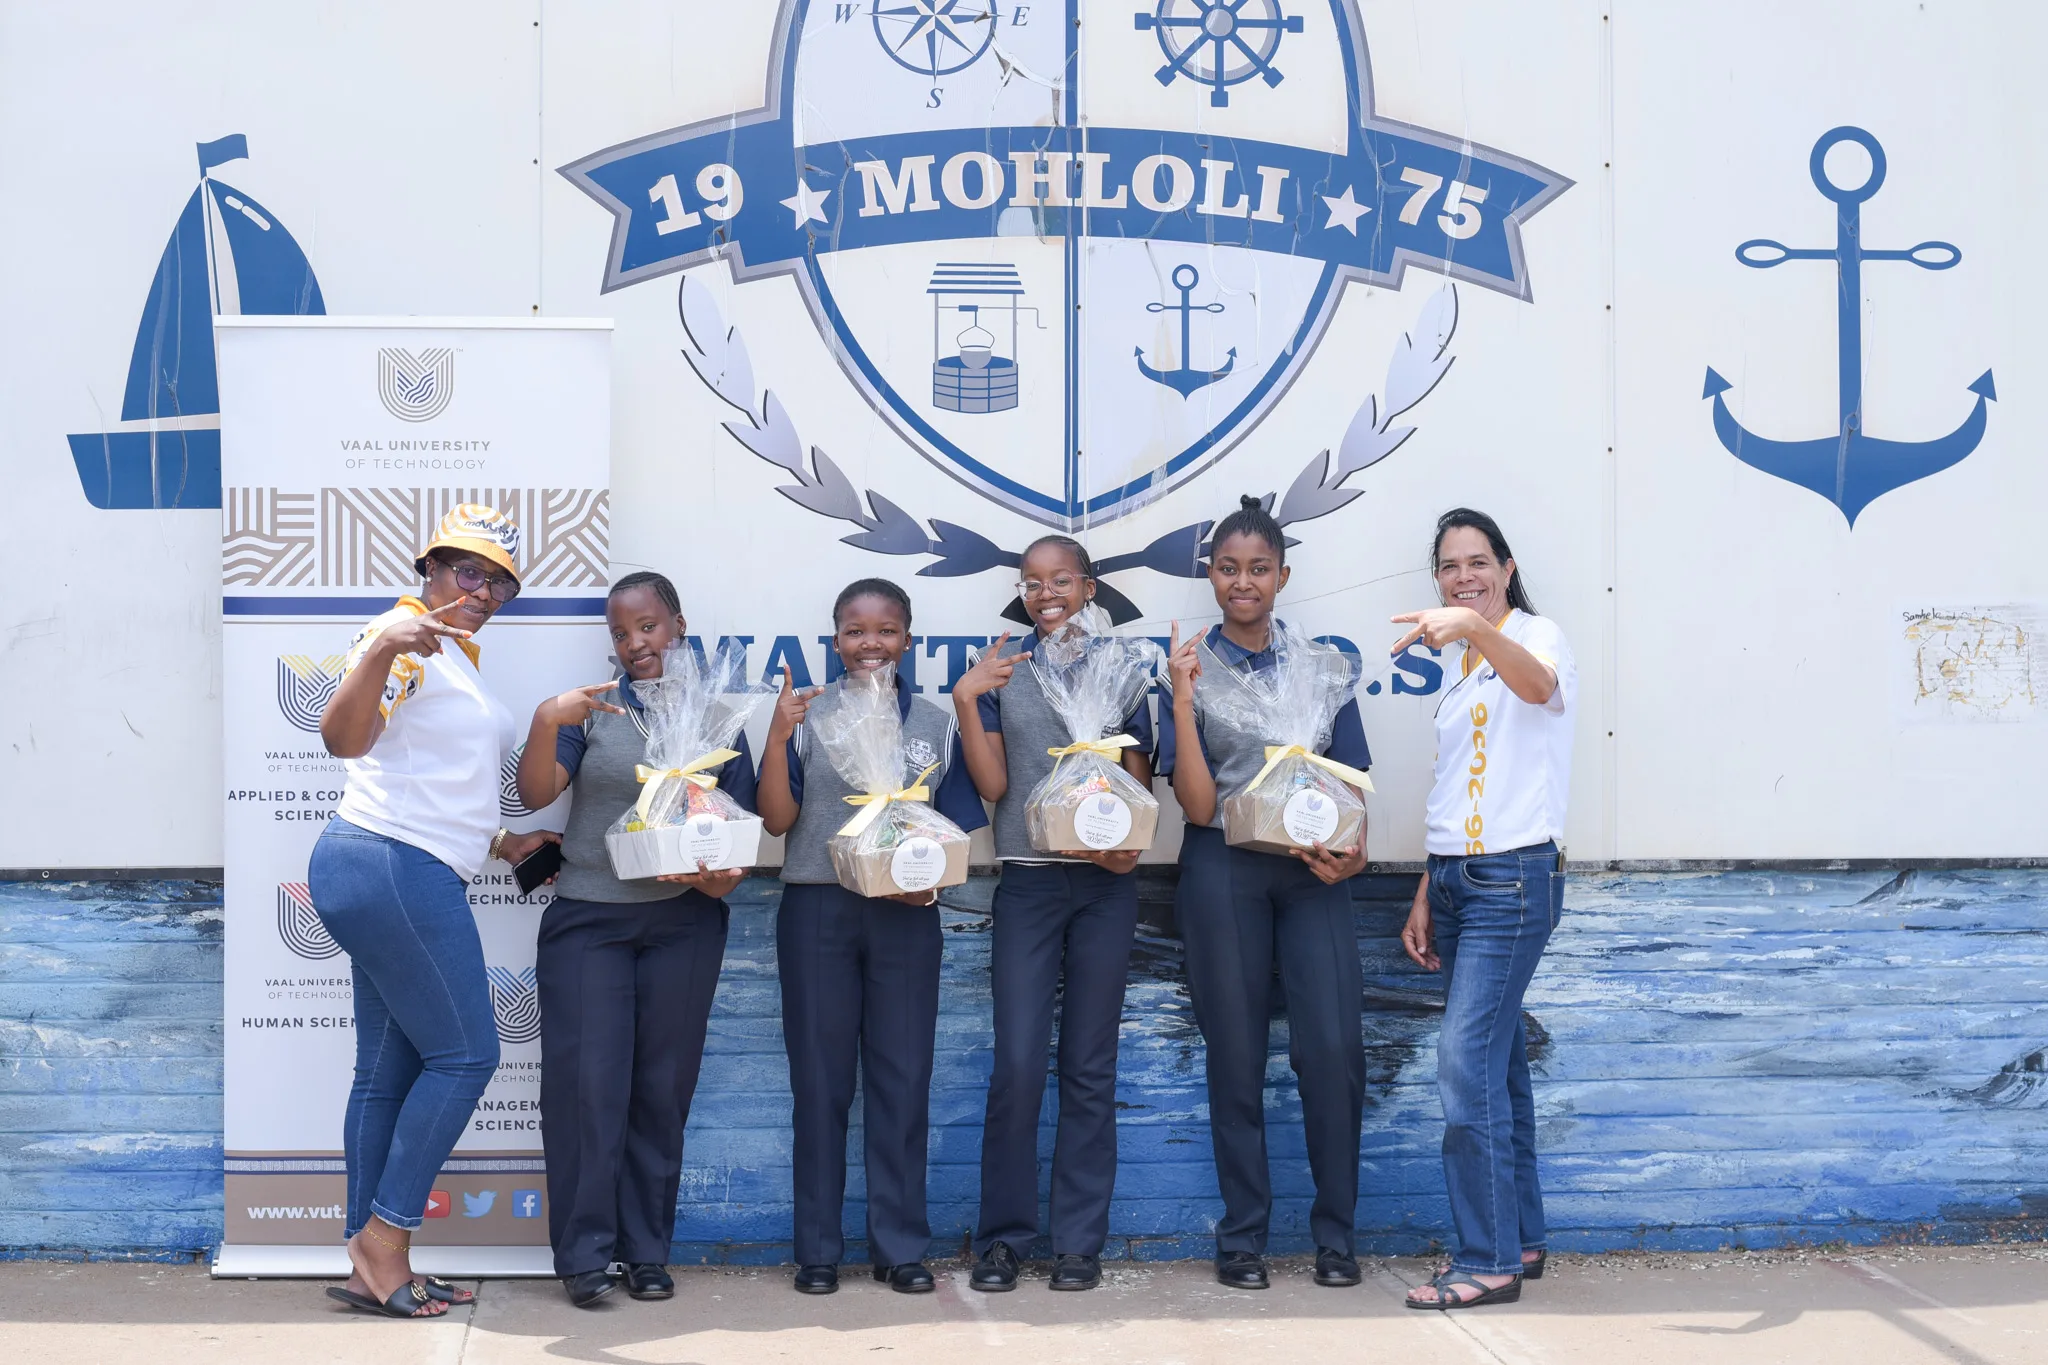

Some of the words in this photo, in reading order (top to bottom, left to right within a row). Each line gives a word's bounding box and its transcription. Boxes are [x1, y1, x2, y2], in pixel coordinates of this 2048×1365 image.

[835, 4, 860, 24] W
[1011, 6, 1030, 27] E
[926, 87, 944, 109] S
[648, 163, 744, 236] 19
[854, 151, 1290, 224] MOHLOLI
[1398, 166, 1488, 240] 75
[341, 440, 384, 451] VAAL
[388, 440, 491, 451] UNIVERSITY
[345, 458, 366, 469] OF
[373, 458, 486, 470] TECHNOLOGY
[265, 751, 295, 759] VAAL
[268, 764, 282, 772] OF
[228, 790, 296, 801] APPLIED
[301, 790, 311, 801] &
[466, 894, 559, 905] ECHNOLO
[265, 979, 295, 987] VAAL
[268, 991, 283, 999] OF
[288, 991, 352, 999] TECHNOLO
[242, 1017, 304, 1028] HUMAN
[247, 1204, 347, 1219] www.vut.
